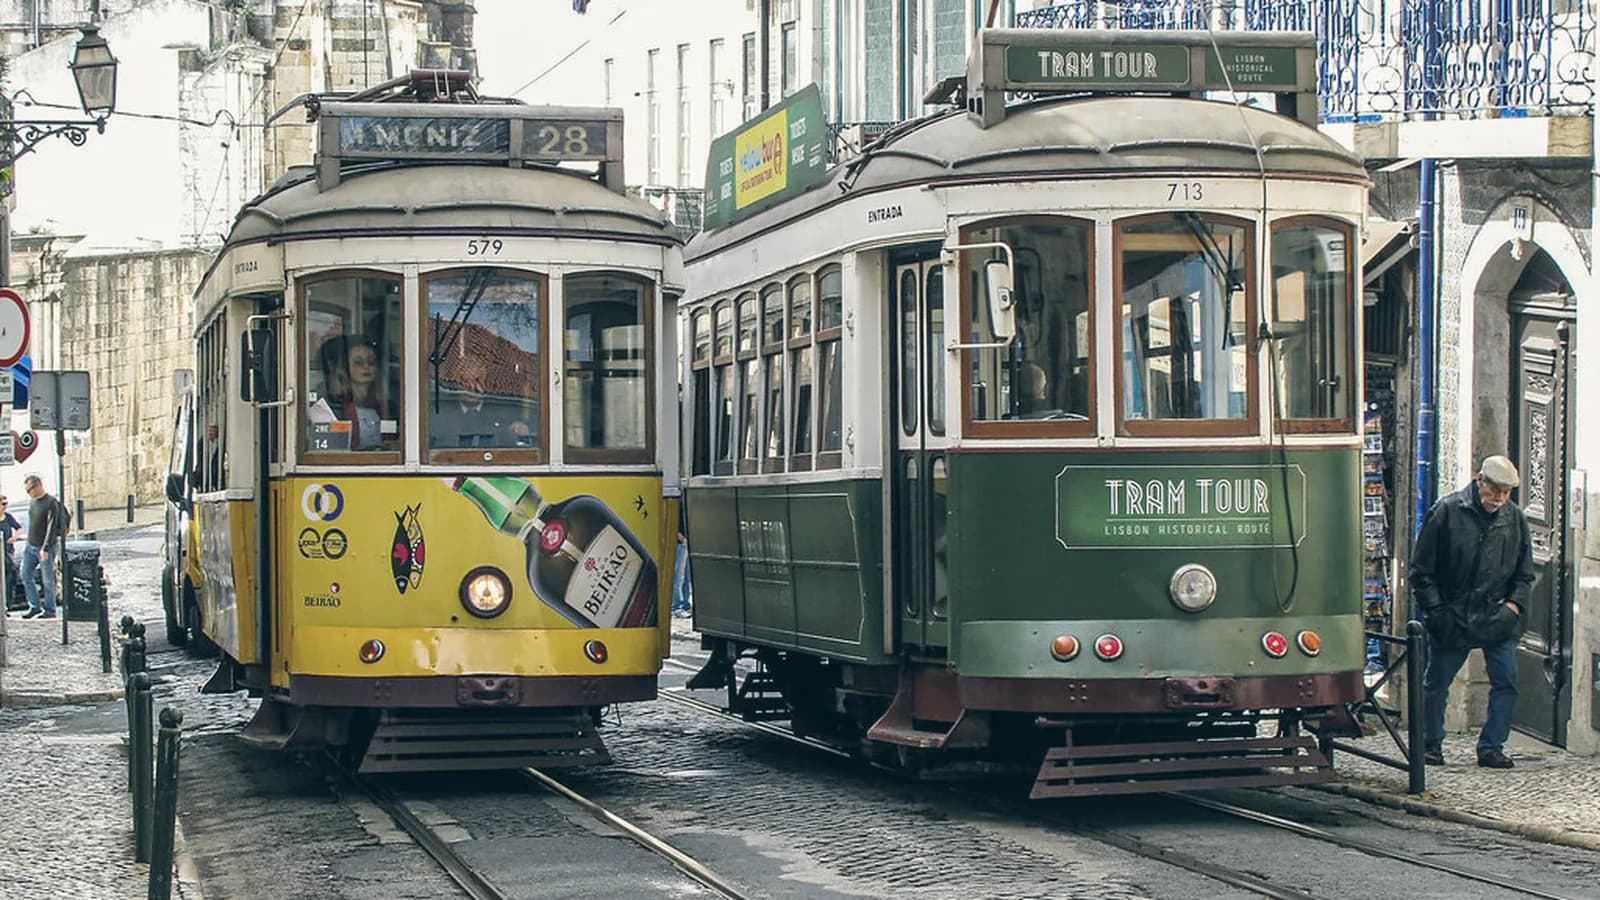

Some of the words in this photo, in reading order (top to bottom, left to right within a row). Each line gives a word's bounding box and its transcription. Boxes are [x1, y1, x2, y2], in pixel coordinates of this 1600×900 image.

[1037, 50, 1094, 79] TRAM
[1100, 50, 1158, 79] TOUR
[1234, 55, 1265, 63] LISBON
[537, 125, 589, 156] 28
[1167, 183, 1204, 202] 713
[868, 204, 903, 223] ENTRADA
[467, 239, 504, 256] 579
[314, 439, 329, 450] 14
[1105, 478, 1186, 515] TRAM
[1195, 478, 1271, 514] TOUR
[1104, 524, 1150, 536] LISBON
[1158, 523, 1228, 536] HISTORICAL
[1237, 522, 1271, 535] ROUTE
[583, 544, 628, 616] BEIRÃO
